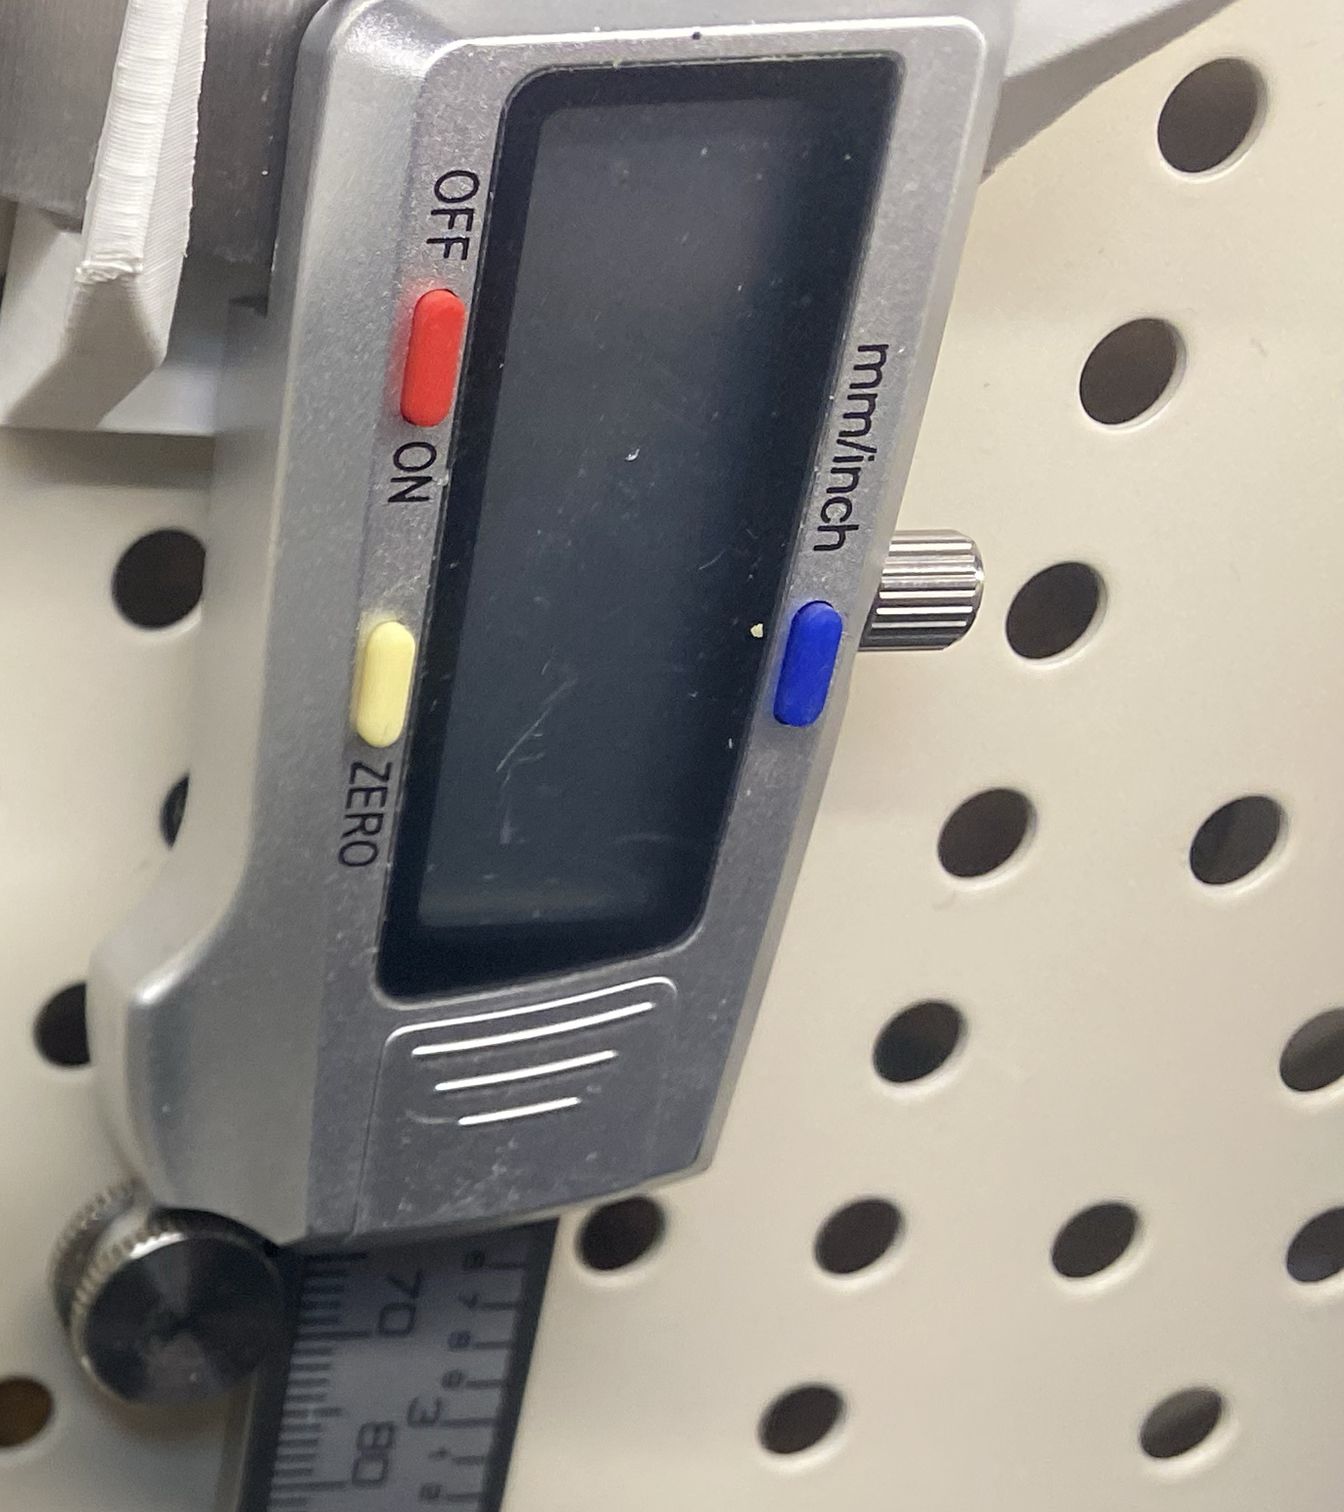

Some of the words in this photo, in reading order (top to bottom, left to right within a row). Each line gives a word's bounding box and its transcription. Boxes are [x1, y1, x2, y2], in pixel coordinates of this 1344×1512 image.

[424, 168, 481, 262] OFF
[387, 441, 438, 504] ON
[812, 342, 889, 552] mm/inch
[337, 760, 394, 868] ZERO
[377, 1269, 424, 1338] 70
[407, 1397, 448, 1426] 3
[351, 1421, 396, 1488] 80
